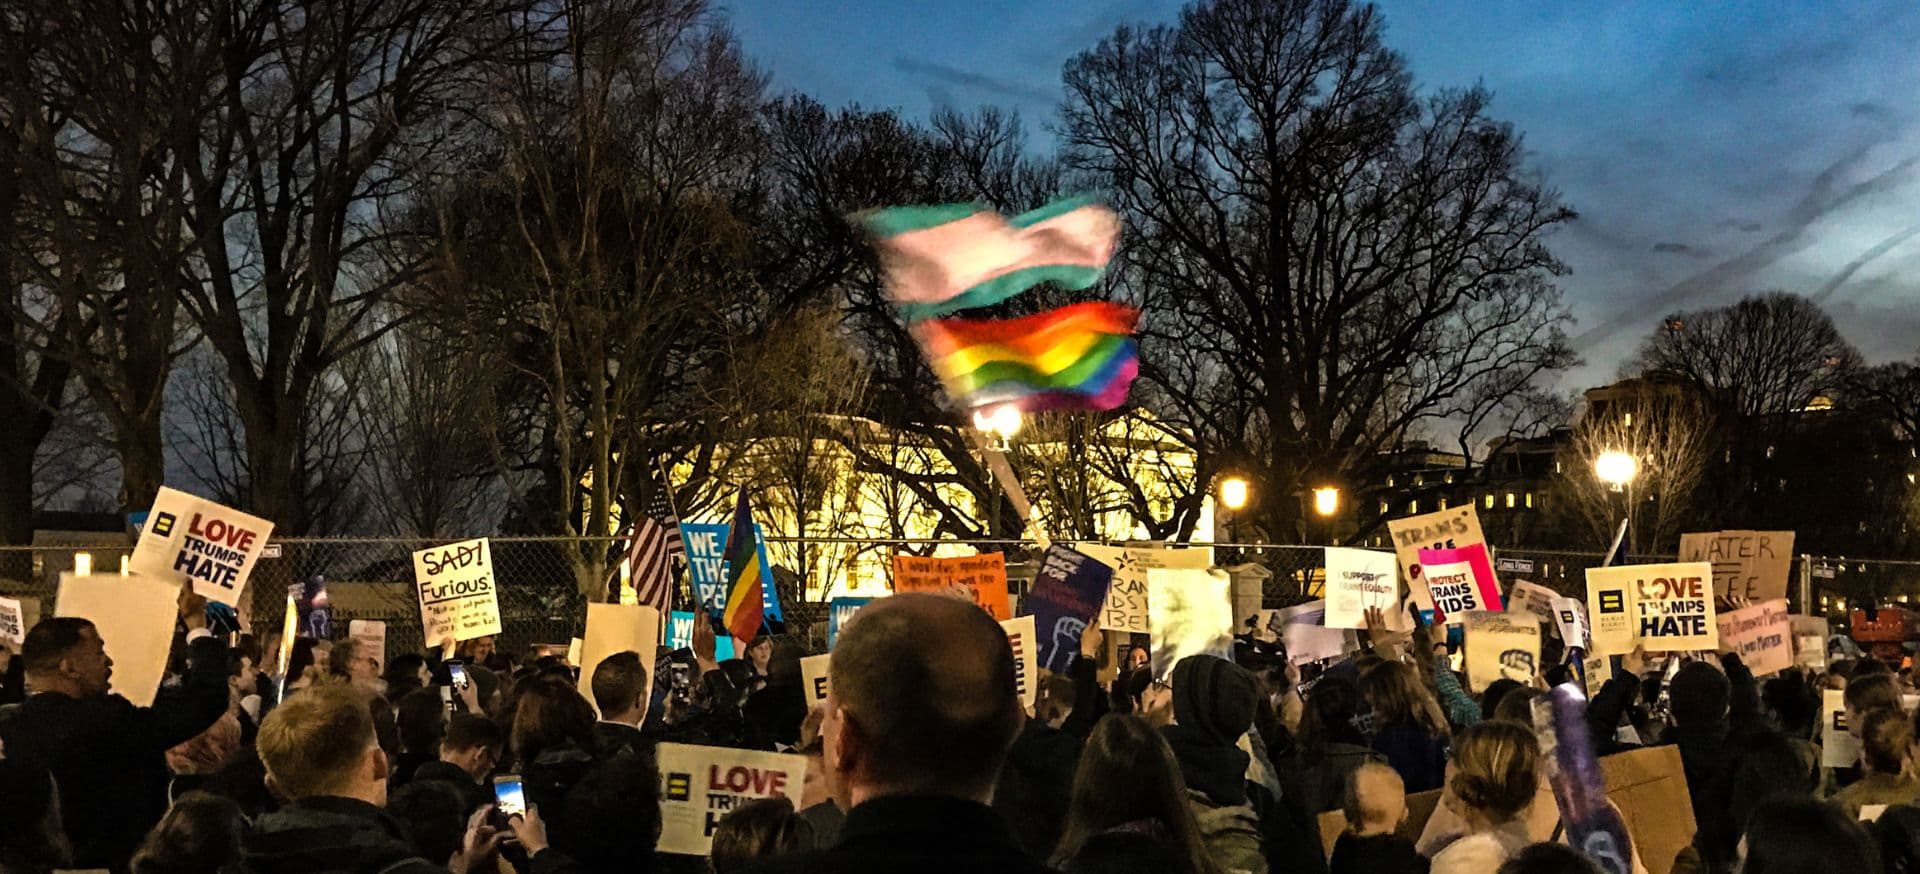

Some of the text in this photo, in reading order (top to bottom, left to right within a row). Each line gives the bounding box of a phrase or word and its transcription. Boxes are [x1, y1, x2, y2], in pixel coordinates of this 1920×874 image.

[188, 512, 256, 552] LOVE
[687, 531, 721, 557] WE
[184, 535, 246, 567] TRUMPS
[422, 541, 483, 575] SAD!
[173, 550, 239, 590] HATE
[692, 557, 730, 582] THE
[1637, 577, 1704, 600] LOVE
[1638, 600, 1705, 616] TUMPS
[1640, 615, 1708, 637] HATE
[708, 764, 788, 796] LOVE
